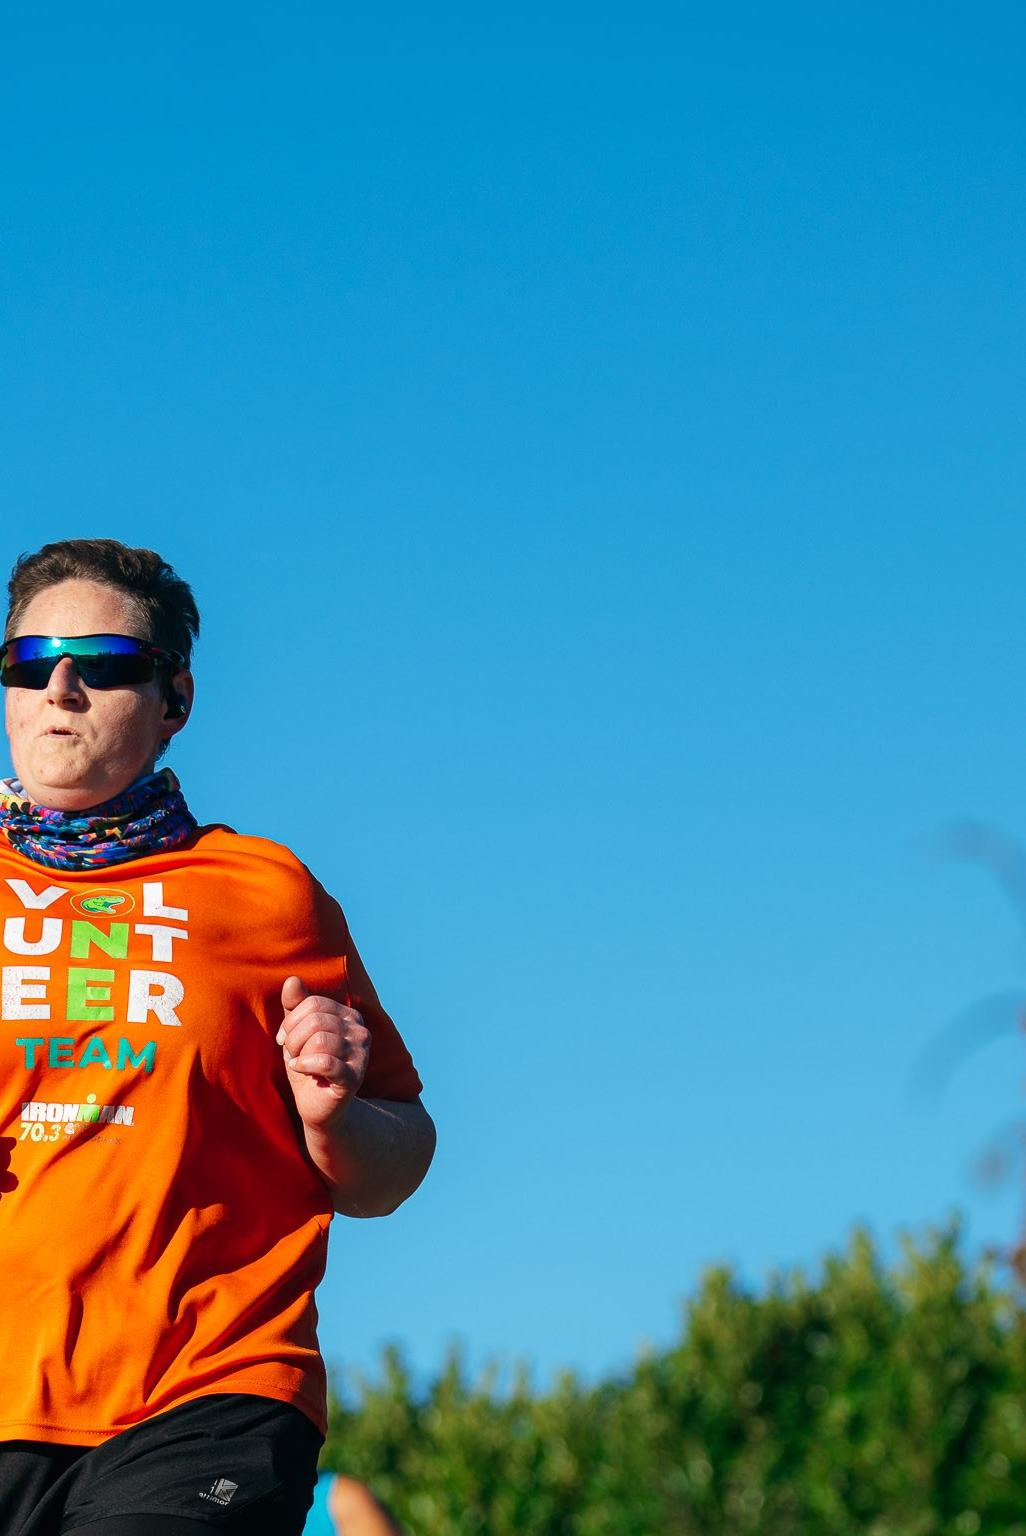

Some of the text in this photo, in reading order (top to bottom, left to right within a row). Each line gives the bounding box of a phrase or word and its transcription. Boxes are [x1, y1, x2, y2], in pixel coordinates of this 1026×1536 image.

[3, 916, 189, 963] UNT
[1, 965, 185, 1026] EER
[15, 1036, 157, 1072] TEAM
[20, 1093, 134, 1126] IRONMAN
[19, 1122, 61, 1142] 70.3
